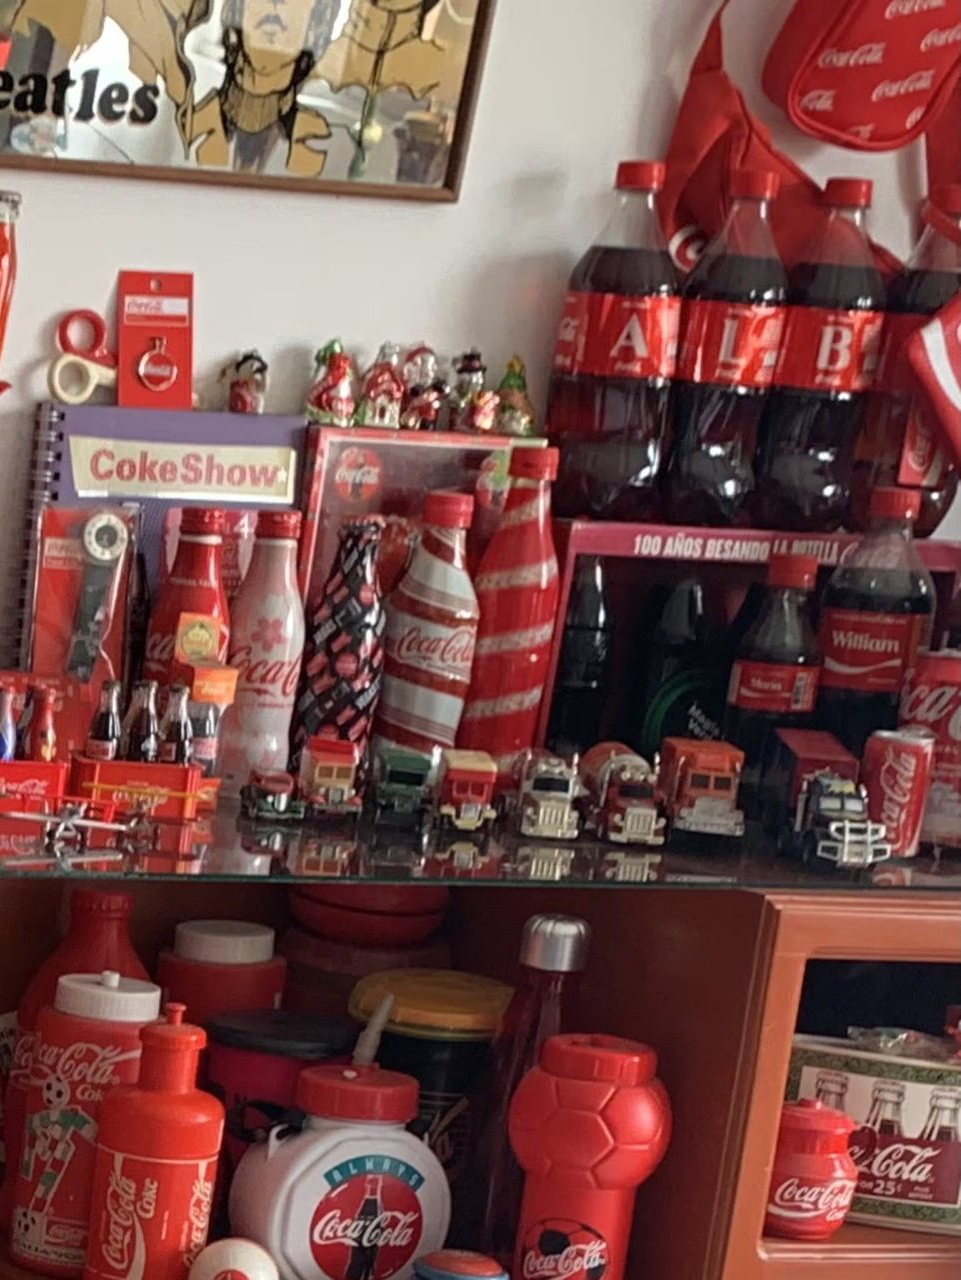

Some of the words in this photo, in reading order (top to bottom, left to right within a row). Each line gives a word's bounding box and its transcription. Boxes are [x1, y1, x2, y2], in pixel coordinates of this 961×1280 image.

[609, 312, 648, 358] A
[816, 324, 853, 371] B
[89, 448, 278, 488] CokeShow
[635, 534, 662, 556] 100
[664, 532, 701, 558] AÑOS
[704, 538, 771, 563] BESANDO
[395, 626, 475, 665] Coca-Cola
[832, 629, 900, 654] William
[331, 1156, 421, 1188] ALWAYS
[135, 1178, 159, 1219] Coke
[101, 1168, 137, 1270] Coca-Cola
[313, 1208, 419, 1250] Coca-Cola
[522, 1240, 608, 1280] Coca-Cola
